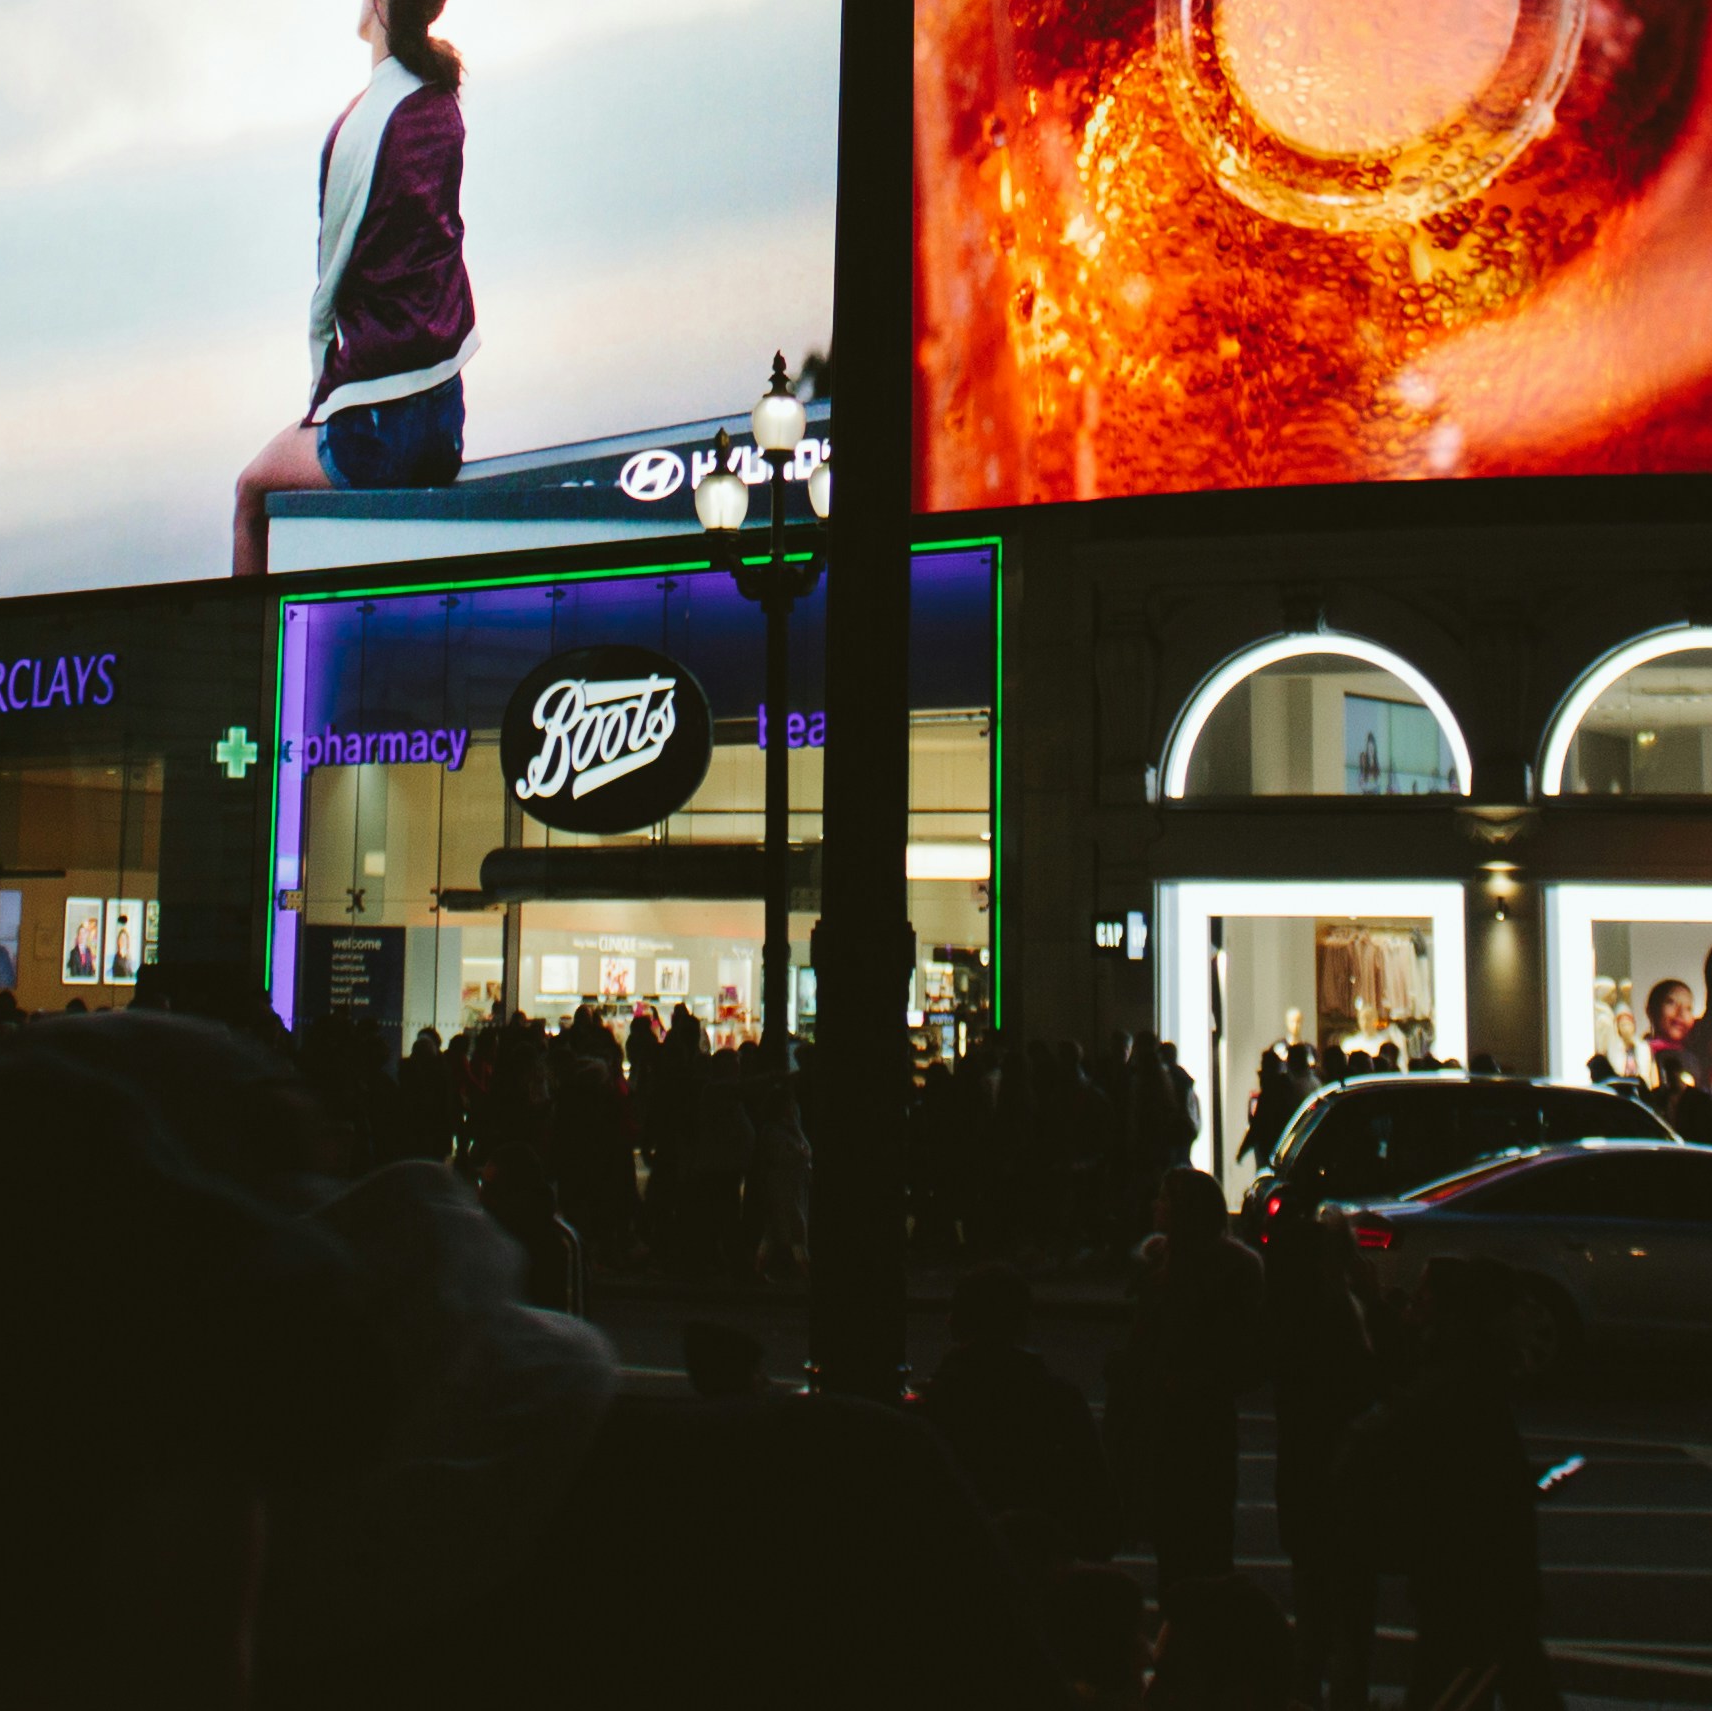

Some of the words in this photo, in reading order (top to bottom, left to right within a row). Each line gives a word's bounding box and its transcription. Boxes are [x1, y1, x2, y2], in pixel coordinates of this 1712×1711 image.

[303, 725, 469, 774] pharmacy
[515, 673, 678, 800] Boots
[332, 936, 382, 951] welcome
